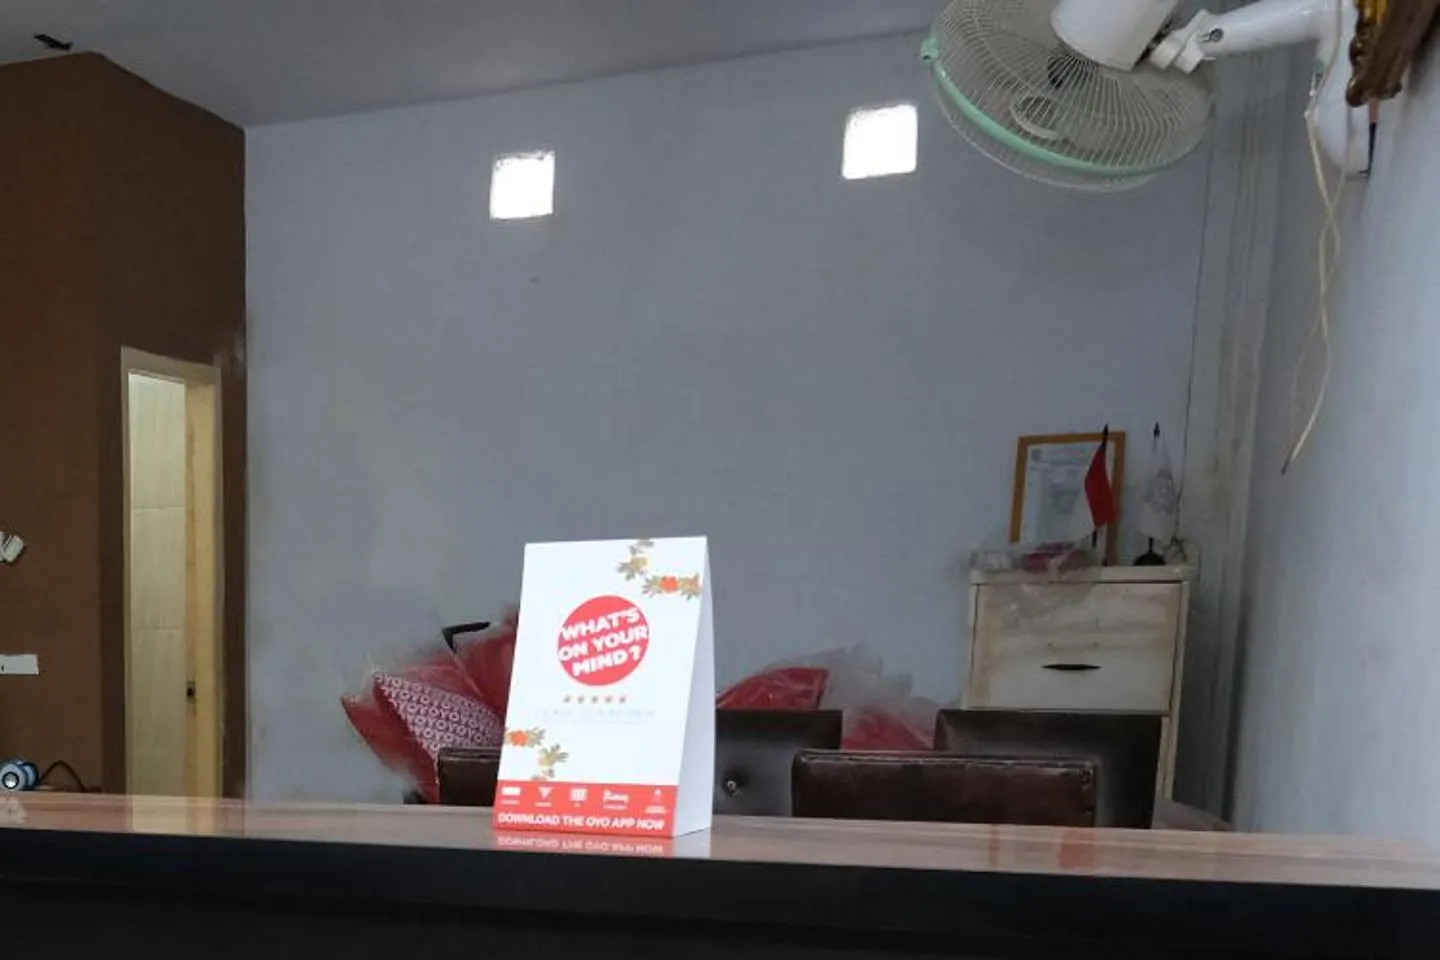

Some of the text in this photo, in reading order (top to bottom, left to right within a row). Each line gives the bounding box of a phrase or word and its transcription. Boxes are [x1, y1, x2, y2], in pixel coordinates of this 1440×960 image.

[560, 606, 640, 641] WHAT'S
[558, 626, 649, 662] ON YOUR
[497, 812, 665, 831] DOWNLOAD THE OYO APP NOW
